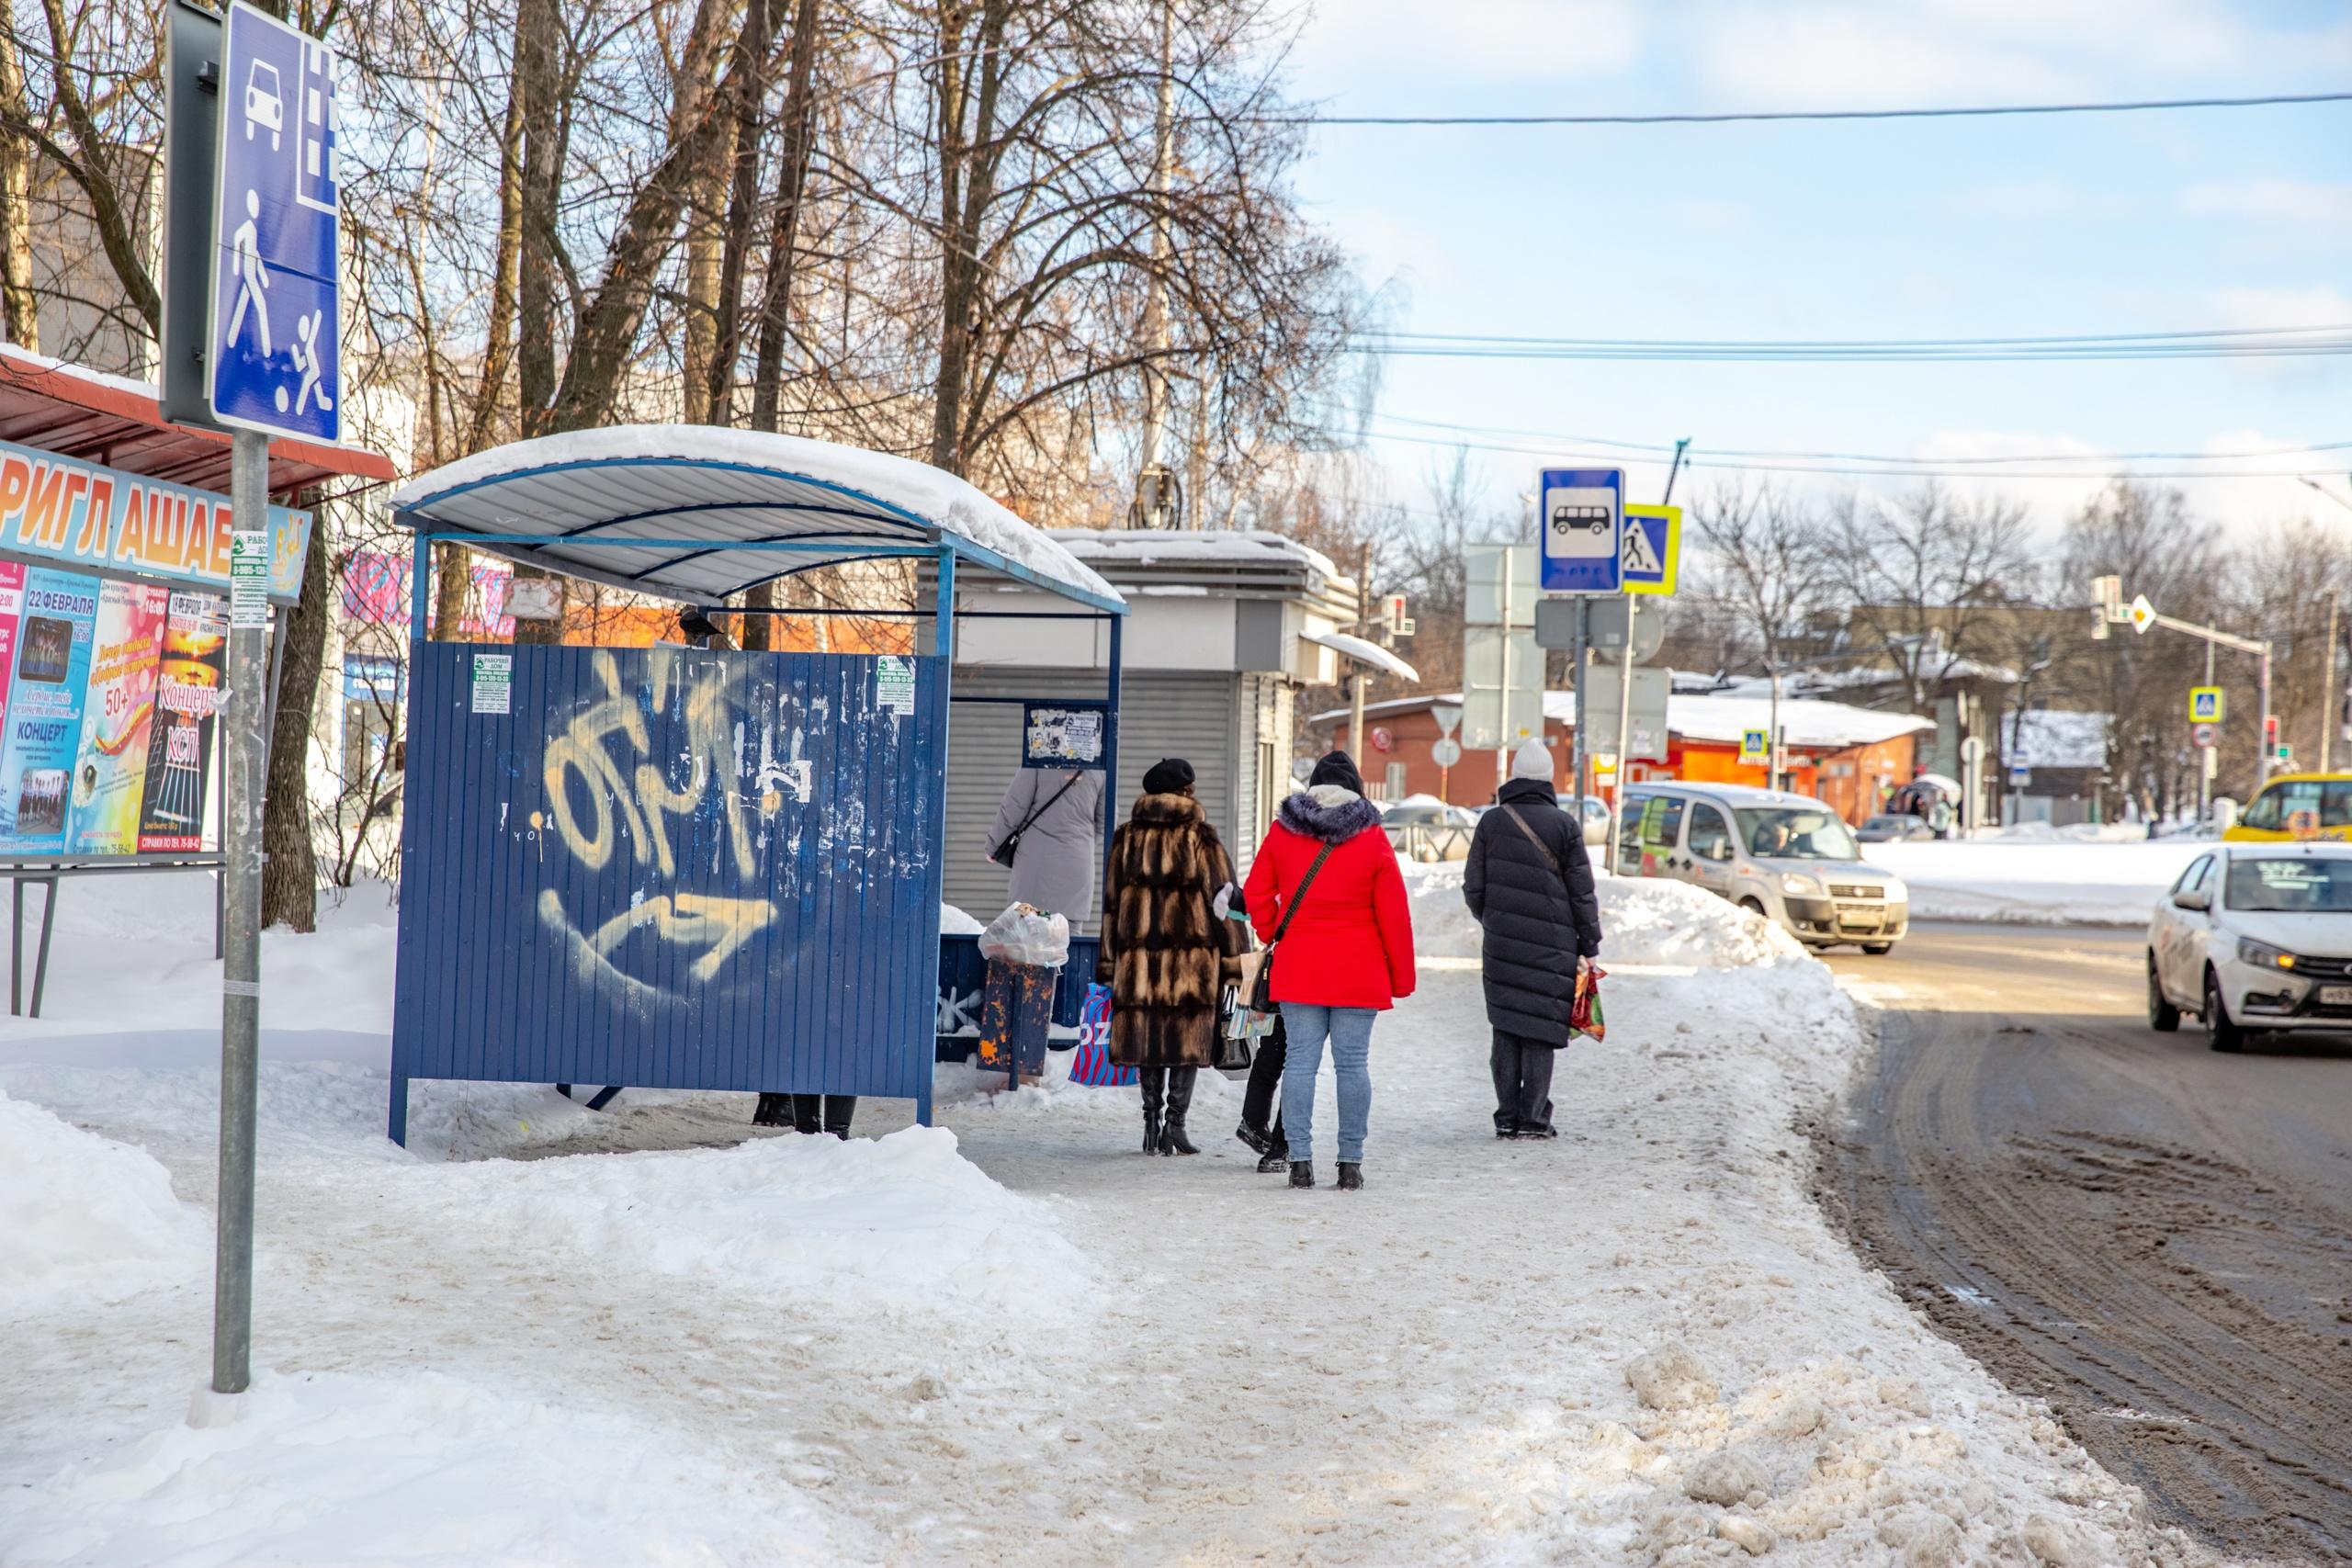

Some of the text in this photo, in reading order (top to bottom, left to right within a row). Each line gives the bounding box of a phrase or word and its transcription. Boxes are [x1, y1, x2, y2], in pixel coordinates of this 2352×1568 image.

[0, 455, 232, 573] РИГЛАШАЕ
[247, 536, 267, 545] РАБО
[28, 590, 95, 615] 22 ФЕВРАЛЯ
[145, 600, 165, 615] 16:00
[106, 688, 128, 716] 50+
[17, 720, 69, 744] КОНЦЕРТ
[167, 728, 198, 761] КСП
[1736, 755, 1771, 766] АПТЕК
